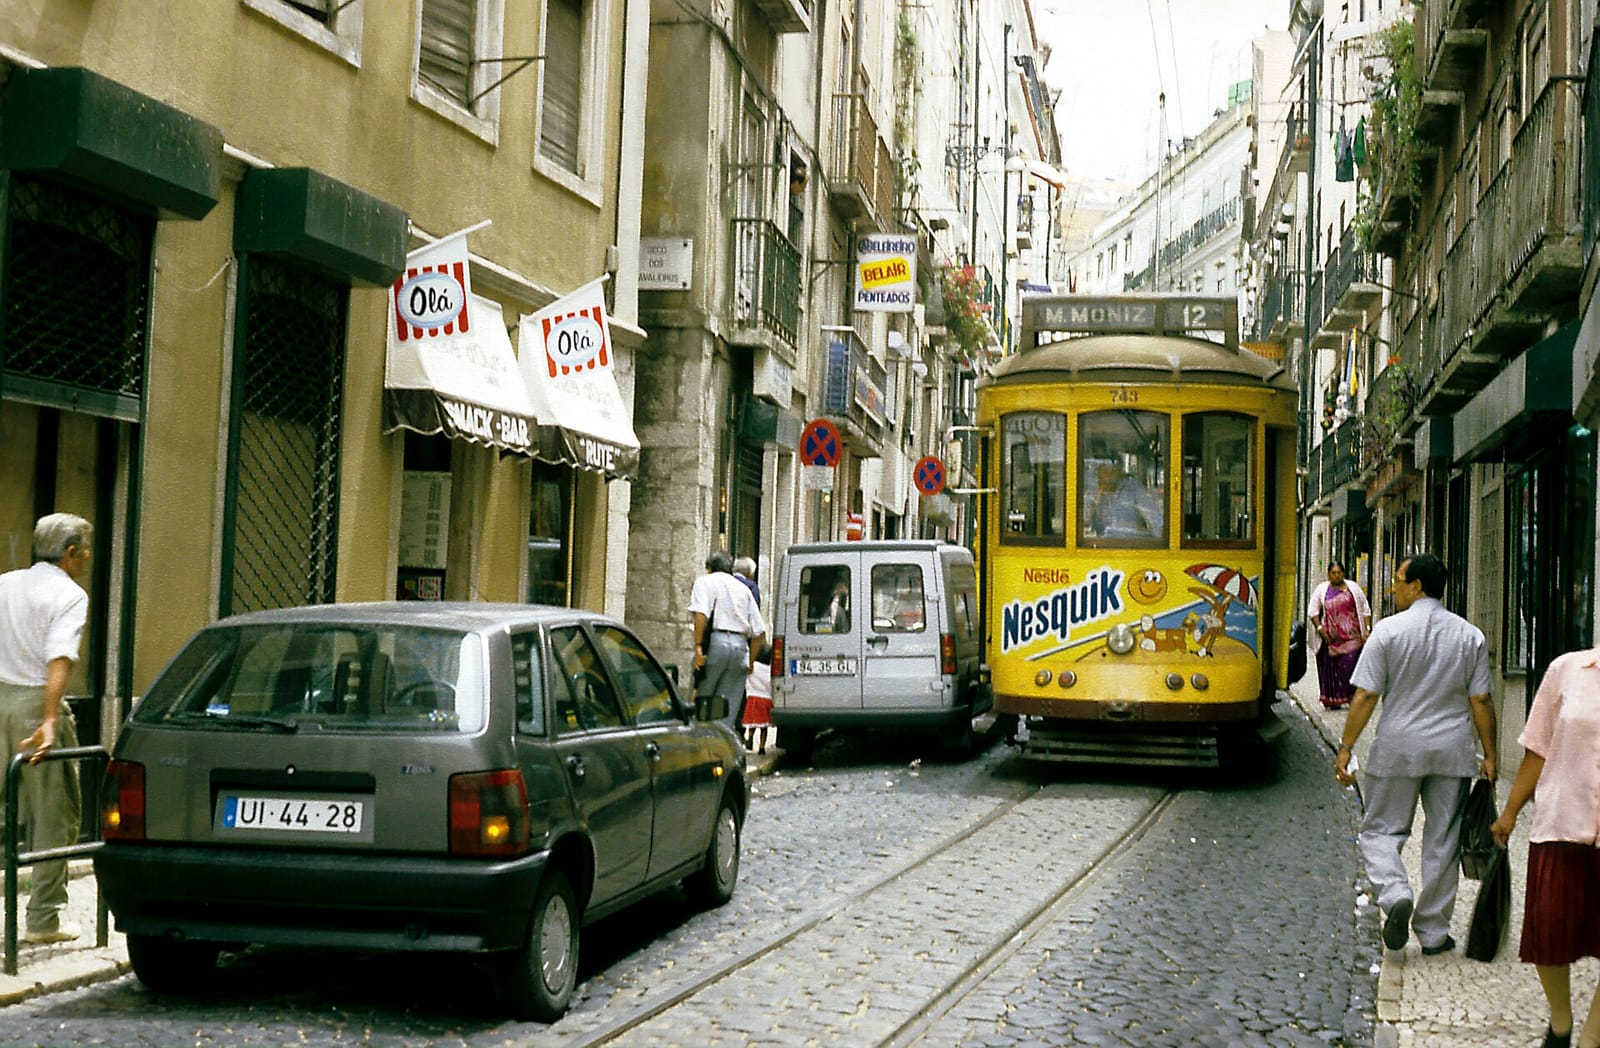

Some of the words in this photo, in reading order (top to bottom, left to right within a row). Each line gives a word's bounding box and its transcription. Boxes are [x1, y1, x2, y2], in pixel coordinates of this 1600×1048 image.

[863, 262, 907, 282] BELAIR
[409, 286, 453, 317] Olá
[857, 290, 911, 304] PENTEADOS
[1183, 304, 1207, 328] 12
[557, 329, 595, 355] Olá
[1109, 389, 1139, 404] 743
[1003, 569, 1122, 652] Nesquik
